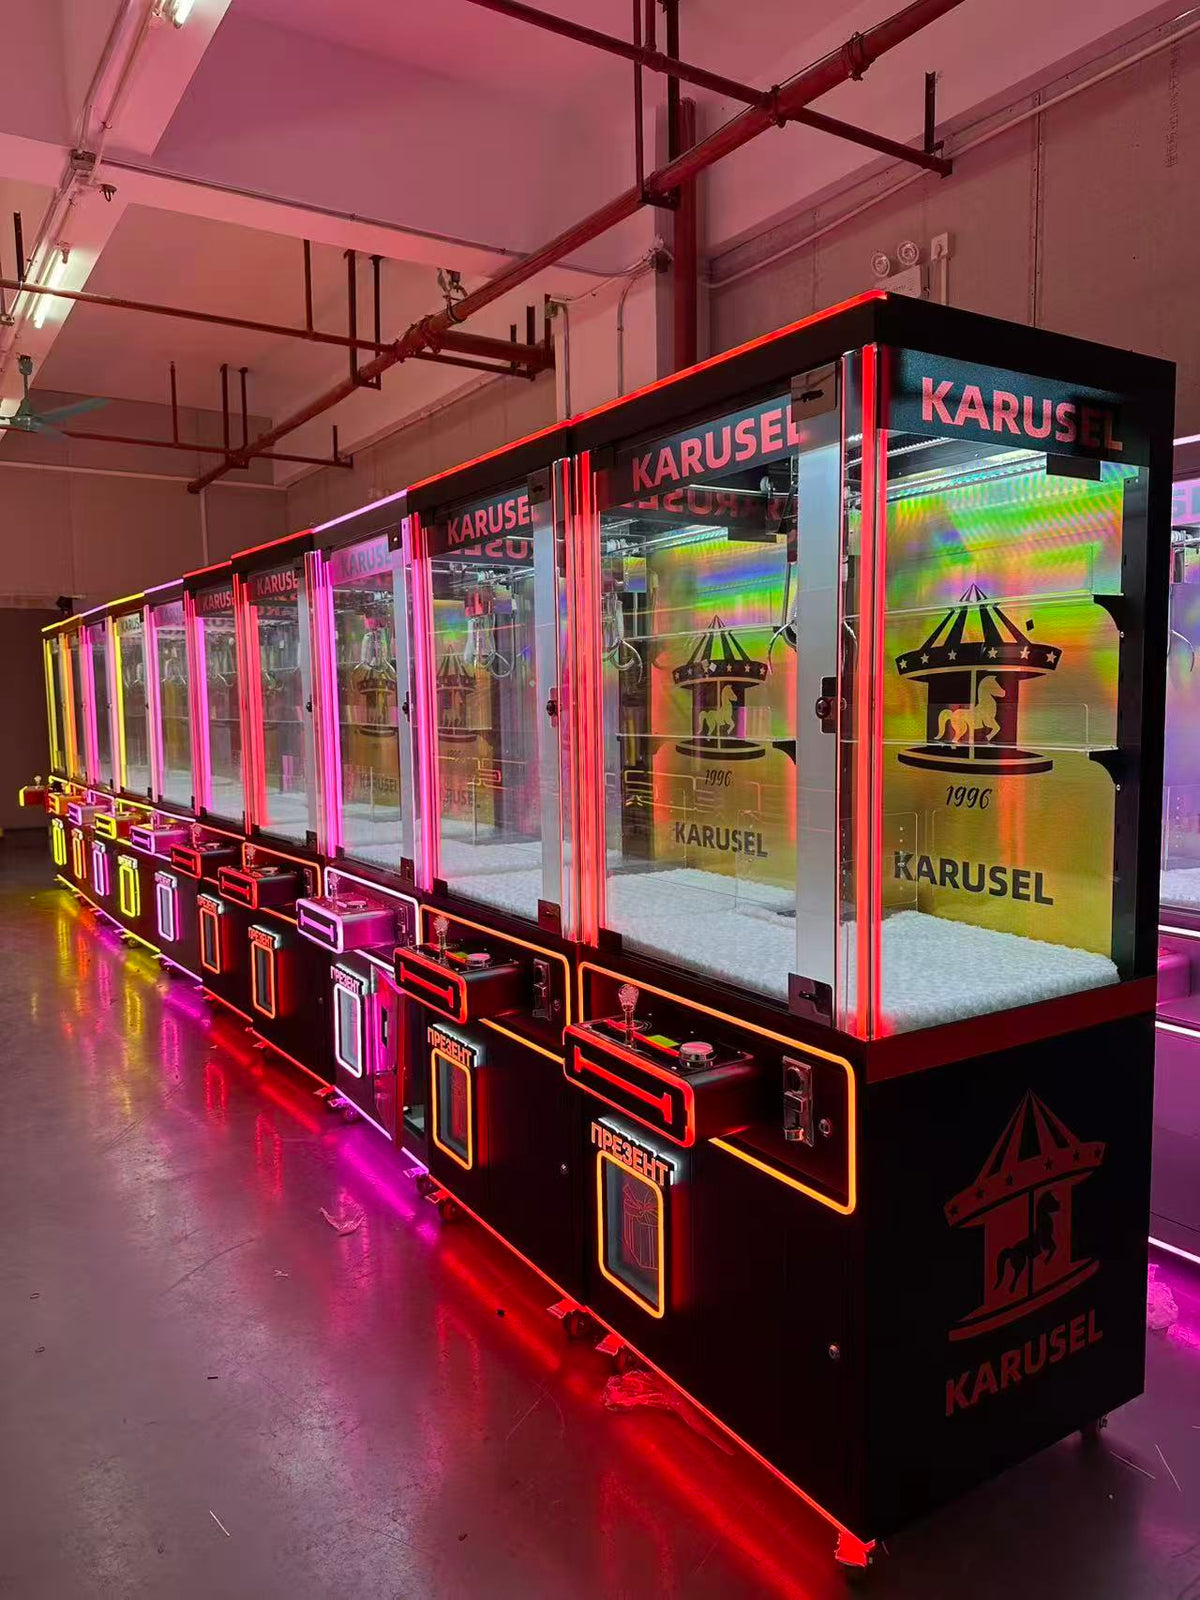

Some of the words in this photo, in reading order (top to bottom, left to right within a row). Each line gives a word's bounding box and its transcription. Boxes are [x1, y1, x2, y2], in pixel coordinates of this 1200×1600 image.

[921, 376, 1123, 451] KARUSEL
[704, 769, 733, 787] 1996
[946, 785, 993, 809] 1996
[674, 821, 768, 858] KARUSEL
[894, 851, 1054, 906] KARUSEL
[427, 1026, 472, 1068] ПРЕЗЕНТ
[590, 1121, 669, 1187] ПРЕЗЕНТ
[945, 1308, 1103, 1417] KARUSEL
